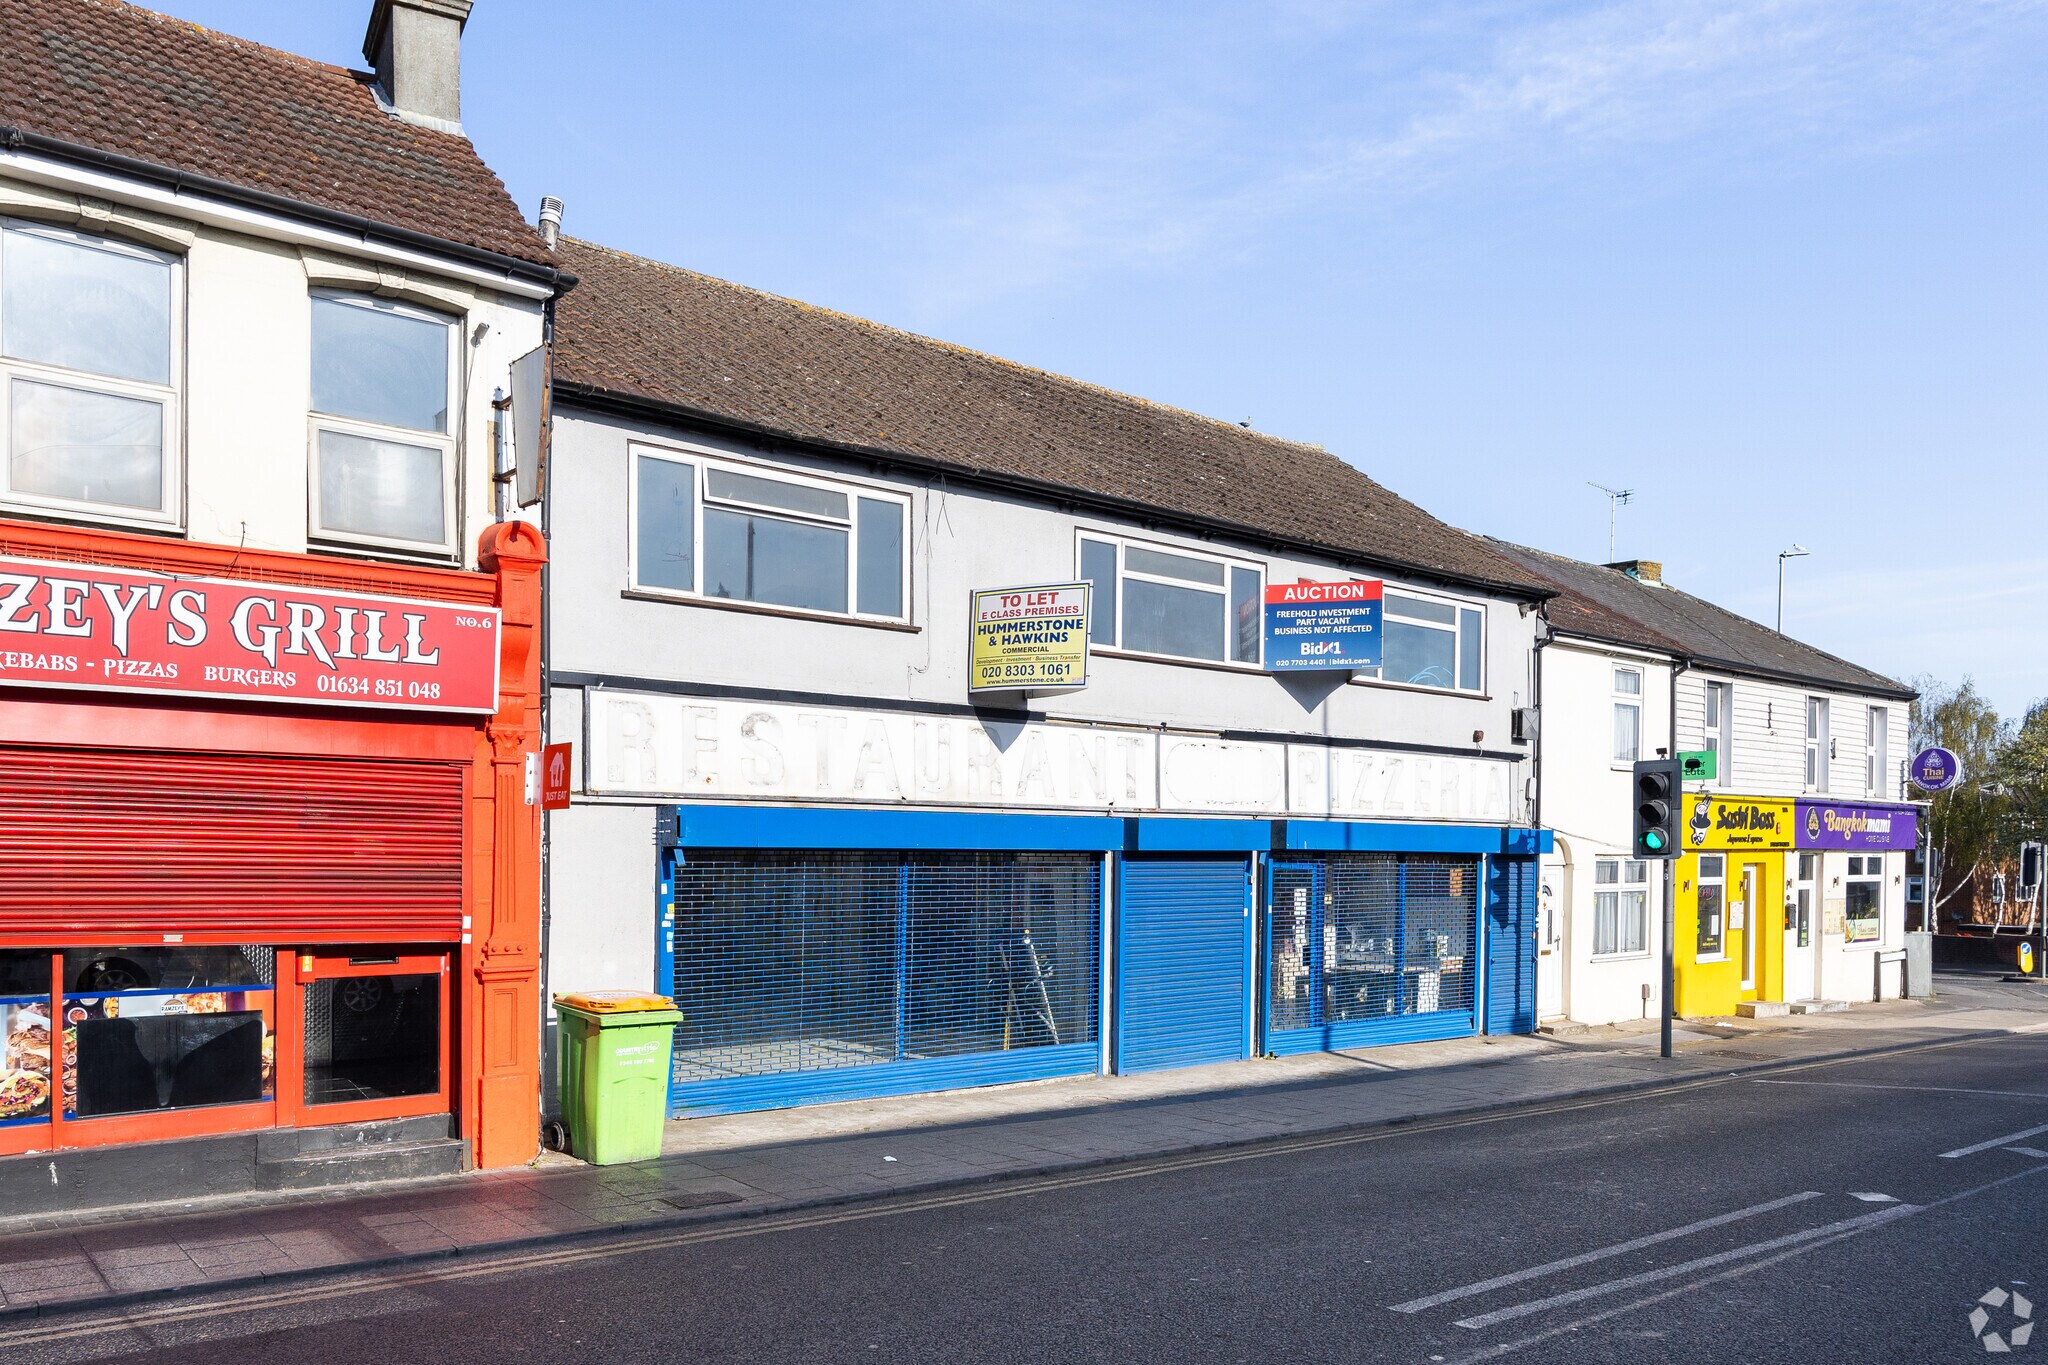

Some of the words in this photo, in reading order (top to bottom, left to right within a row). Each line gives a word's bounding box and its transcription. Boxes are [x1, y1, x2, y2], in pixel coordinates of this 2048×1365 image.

[1284, 585, 1364, 600] AUCTION
[1001, 595, 1021, 608] TO
[1027, 592, 1059, 606] LET
[982, 612, 988, 620] E
[991, 609, 1021, 619] CLASS
[1025, 606, 1079, 616] PREMISES
[1276, 609, 1317, 618] FREEHOLD
[1319, 608, 1371, 616] INVESTMENT
[978, 619, 1083, 635] HUMMERSTONE
[1296, 618, 1316, 626] PART
[1318, 617, 1350, 625] VACANT
[228, 596, 440, 670] GRILL
[1275, 626, 1312, 635] BUSINESS
[1333, 625, 1372, 633] AFFECTED
[989, 636, 997, 646] &
[1002, 632, 1068, 645] HAWKINS
[1002, 646, 1049, 654] COMMERCIAL
[982, 667, 1001, 678] 020
[1006, 665, 1035, 676] 8303
[1040, 664, 1070, 675] 1061
[103, 659, 178, 678] PIZZAS
[204, 666, 296, 688] BURGERS
[317, 675, 369, 694] 01634
[375, 679, 403, 697] 851
[408, 681, 440, 699] 048
[606, 698, 1145, 801] RESTAURANT
[1922, 767, 1944, 775] Thai
[1298, 751, 1506, 816] PIZZERIA
[545, 791, 557, 802] JUST
[558, 791, 567, 800] EAT
